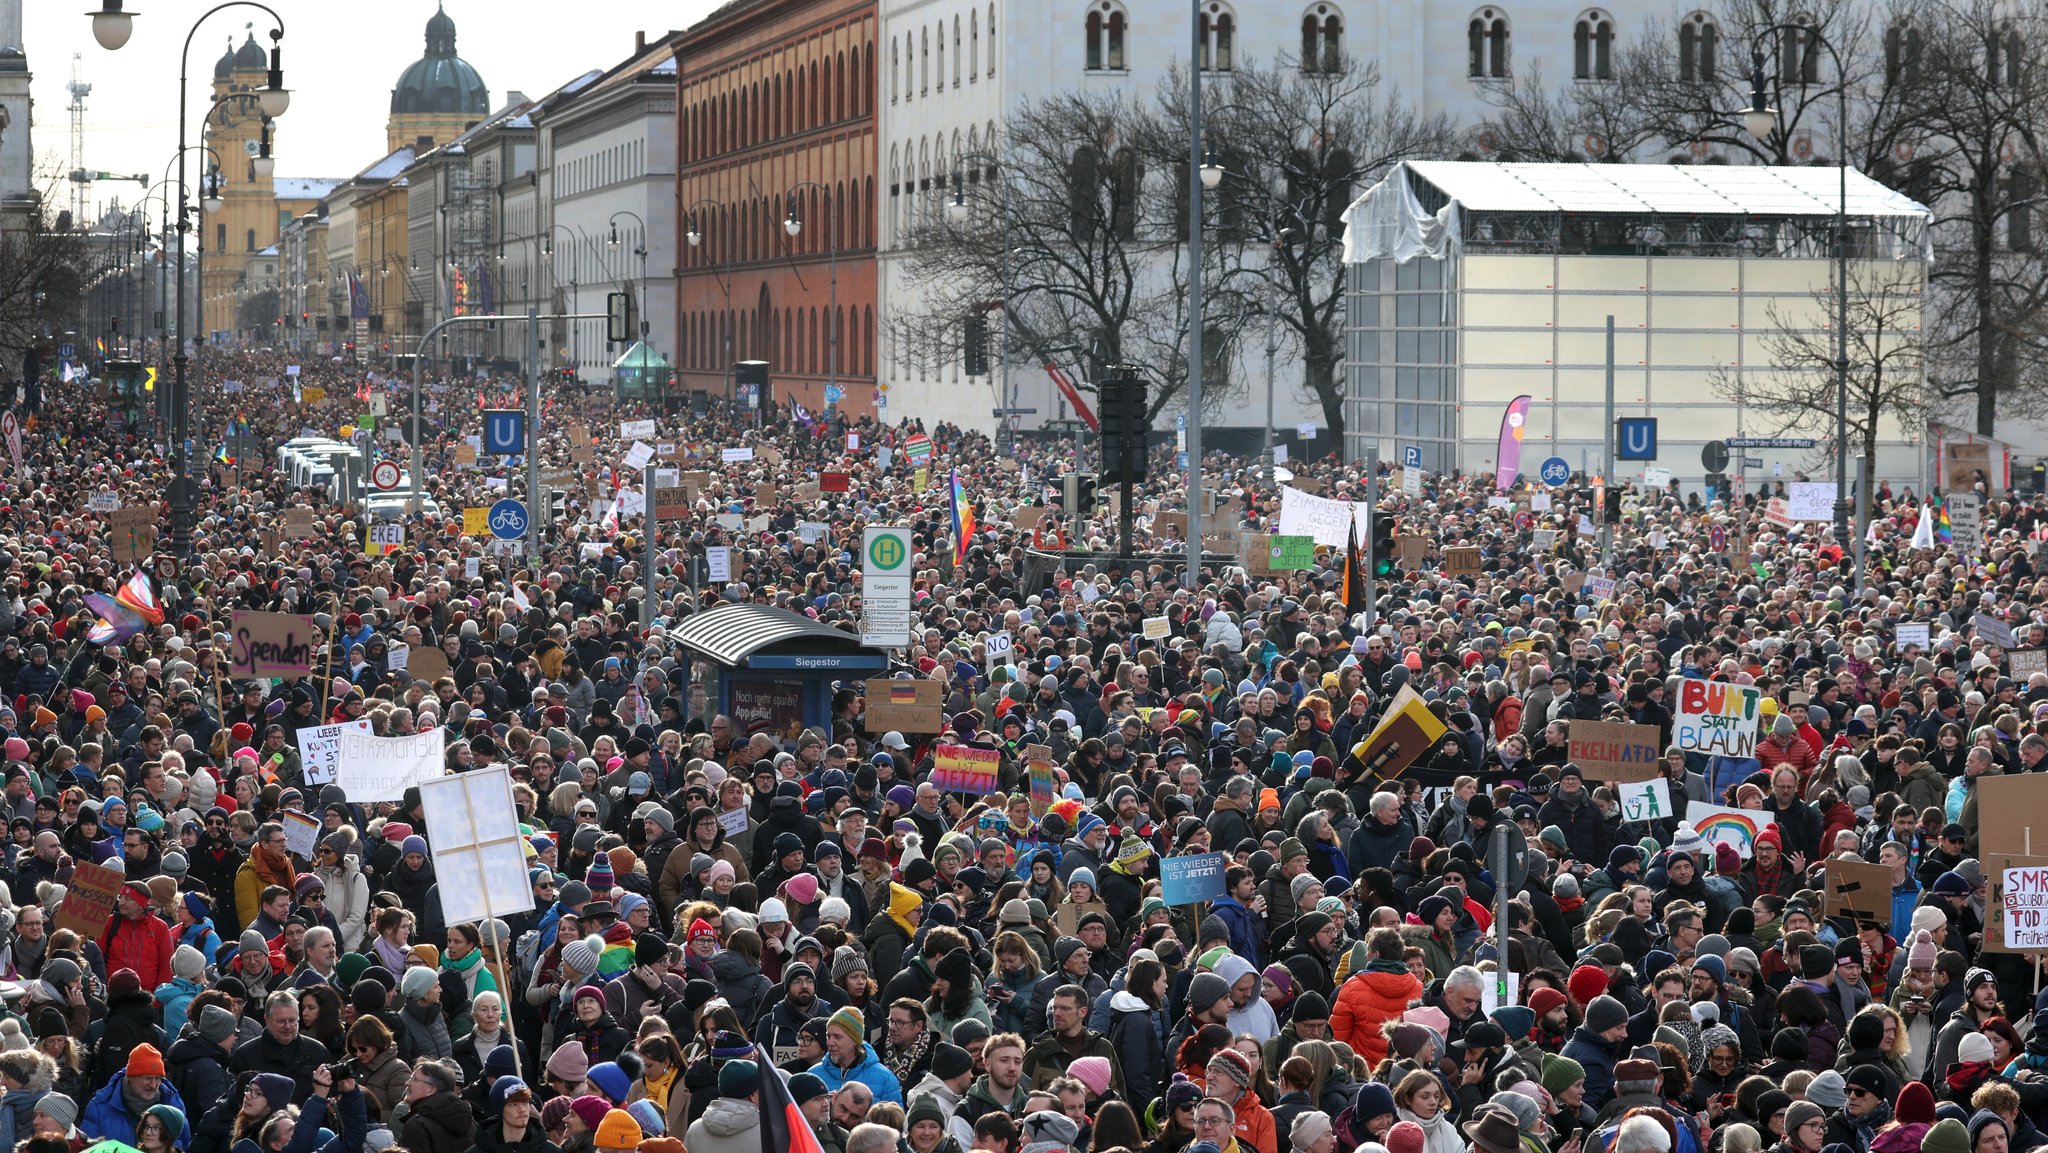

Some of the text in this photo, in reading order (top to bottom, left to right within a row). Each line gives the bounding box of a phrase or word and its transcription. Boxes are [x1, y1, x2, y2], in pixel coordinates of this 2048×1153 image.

[495, 419, 515, 447] U
[1628, 426, 1648, 453] U
[1406, 448, 1417, 464] P
[1289, 493, 1350, 518] ZIMMERE
[1810, 498, 1832, 507] GEGE
[1309, 513, 1348, 529] GEGEN
[370, 527, 402, 543] EKEL
[1274, 536, 1285, 545] NIE
[1286, 546, 1297, 554] IST
[1281, 555, 1308, 567] JETZT
[233, 627, 309, 674] Spenden
[987, 636, 1010, 655] NO
[795, 657, 841, 668] Siegestor
[735, 690, 799, 708] Noch mehr sparen?
[1681, 679, 1760, 721] BUNT
[735, 705, 750, 721] App
[1701, 714, 1740, 730] STATT
[1679, 726, 1755, 757] BLAUN
[938, 747, 999, 763] NIE WIEDER
[958, 763, 976, 771] IST
[937, 769, 996, 793] JETZT!
[1627, 797, 1640, 805] AFD
[1163, 857, 1221, 872] NIE WIEDER
[75, 862, 122, 891] ALLE
[1169, 867, 1217, 881] IST JETZT!
[2010, 910, 2041, 928] TOD
[776, 1051, 798, 1062] FAS
